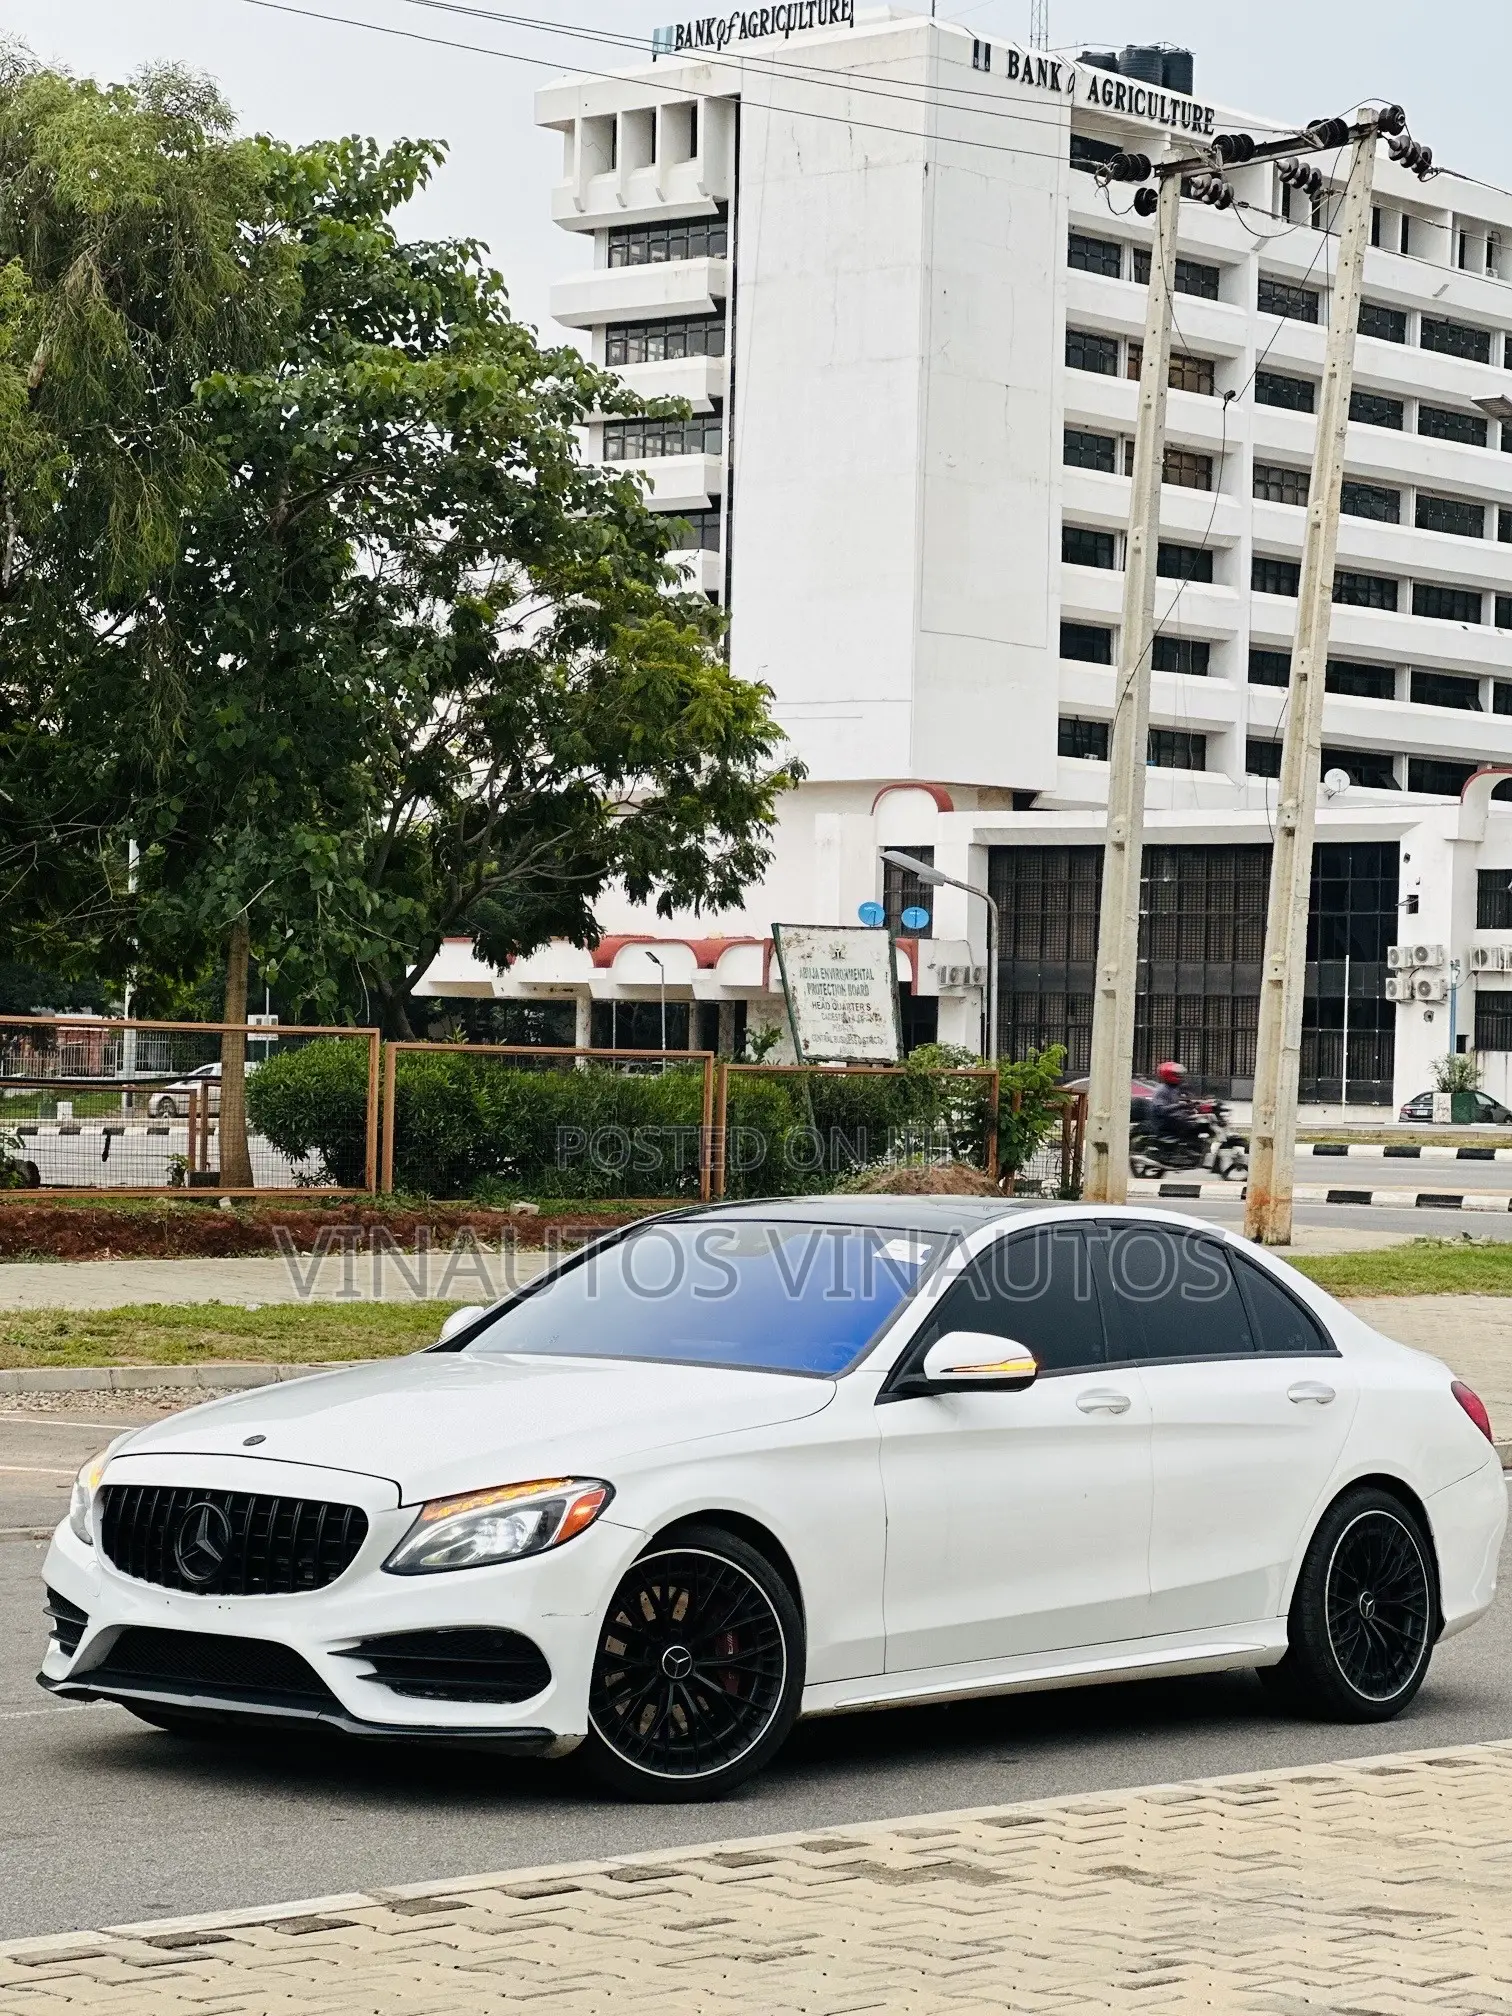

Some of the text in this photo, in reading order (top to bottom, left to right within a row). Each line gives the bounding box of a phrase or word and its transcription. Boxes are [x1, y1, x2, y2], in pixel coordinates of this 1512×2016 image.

[674, 0, 854, 51] BANK of AGRICULTURE
[1007, 50, 1063, 92] BANK
[1087, 74, 1216, 136] AGRICULTURE
[820, 967, 875, 981] ENVIRONMENTAL
[806, 983, 870, 997] PROTECTION BOARD
[812, 1001, 831, 1011] HEAD
